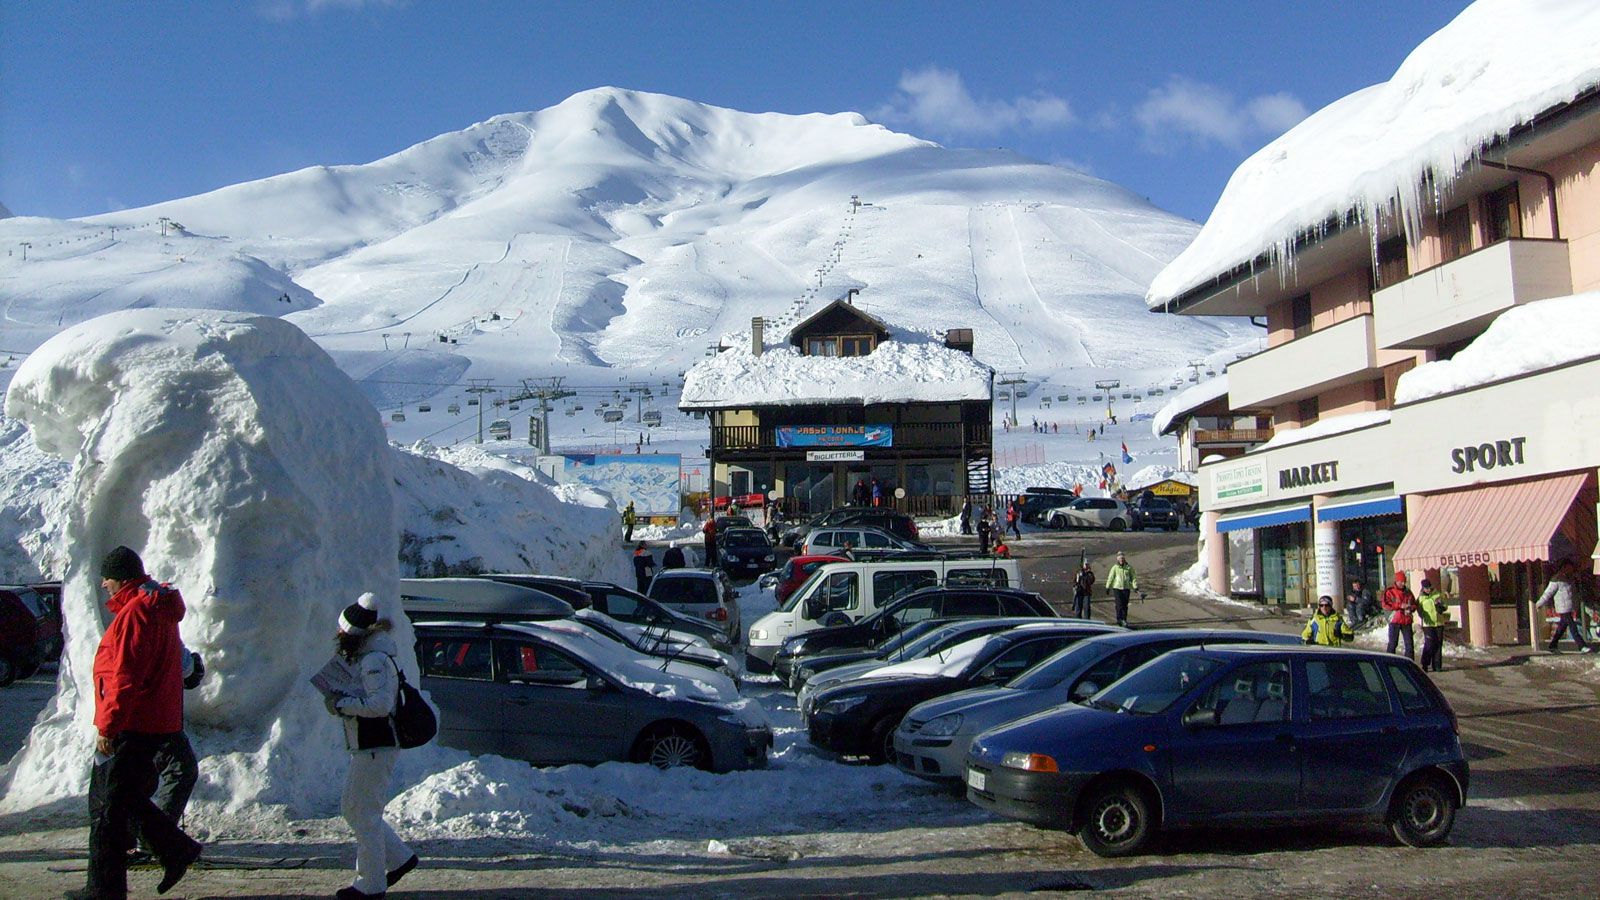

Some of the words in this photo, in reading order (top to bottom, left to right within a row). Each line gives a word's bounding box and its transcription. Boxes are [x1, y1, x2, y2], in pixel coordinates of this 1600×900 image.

[797, 427, 826, 435] PASSO
[831, 426, 865, 434] TONALE
[813, 451, 857, 461] BIGLIETTERIA
[1451, 437, 1526, 474] SPORT
[1279, 460, 1339, 490] MARKET
[1440, 552, 1490, 566] DELPERO
